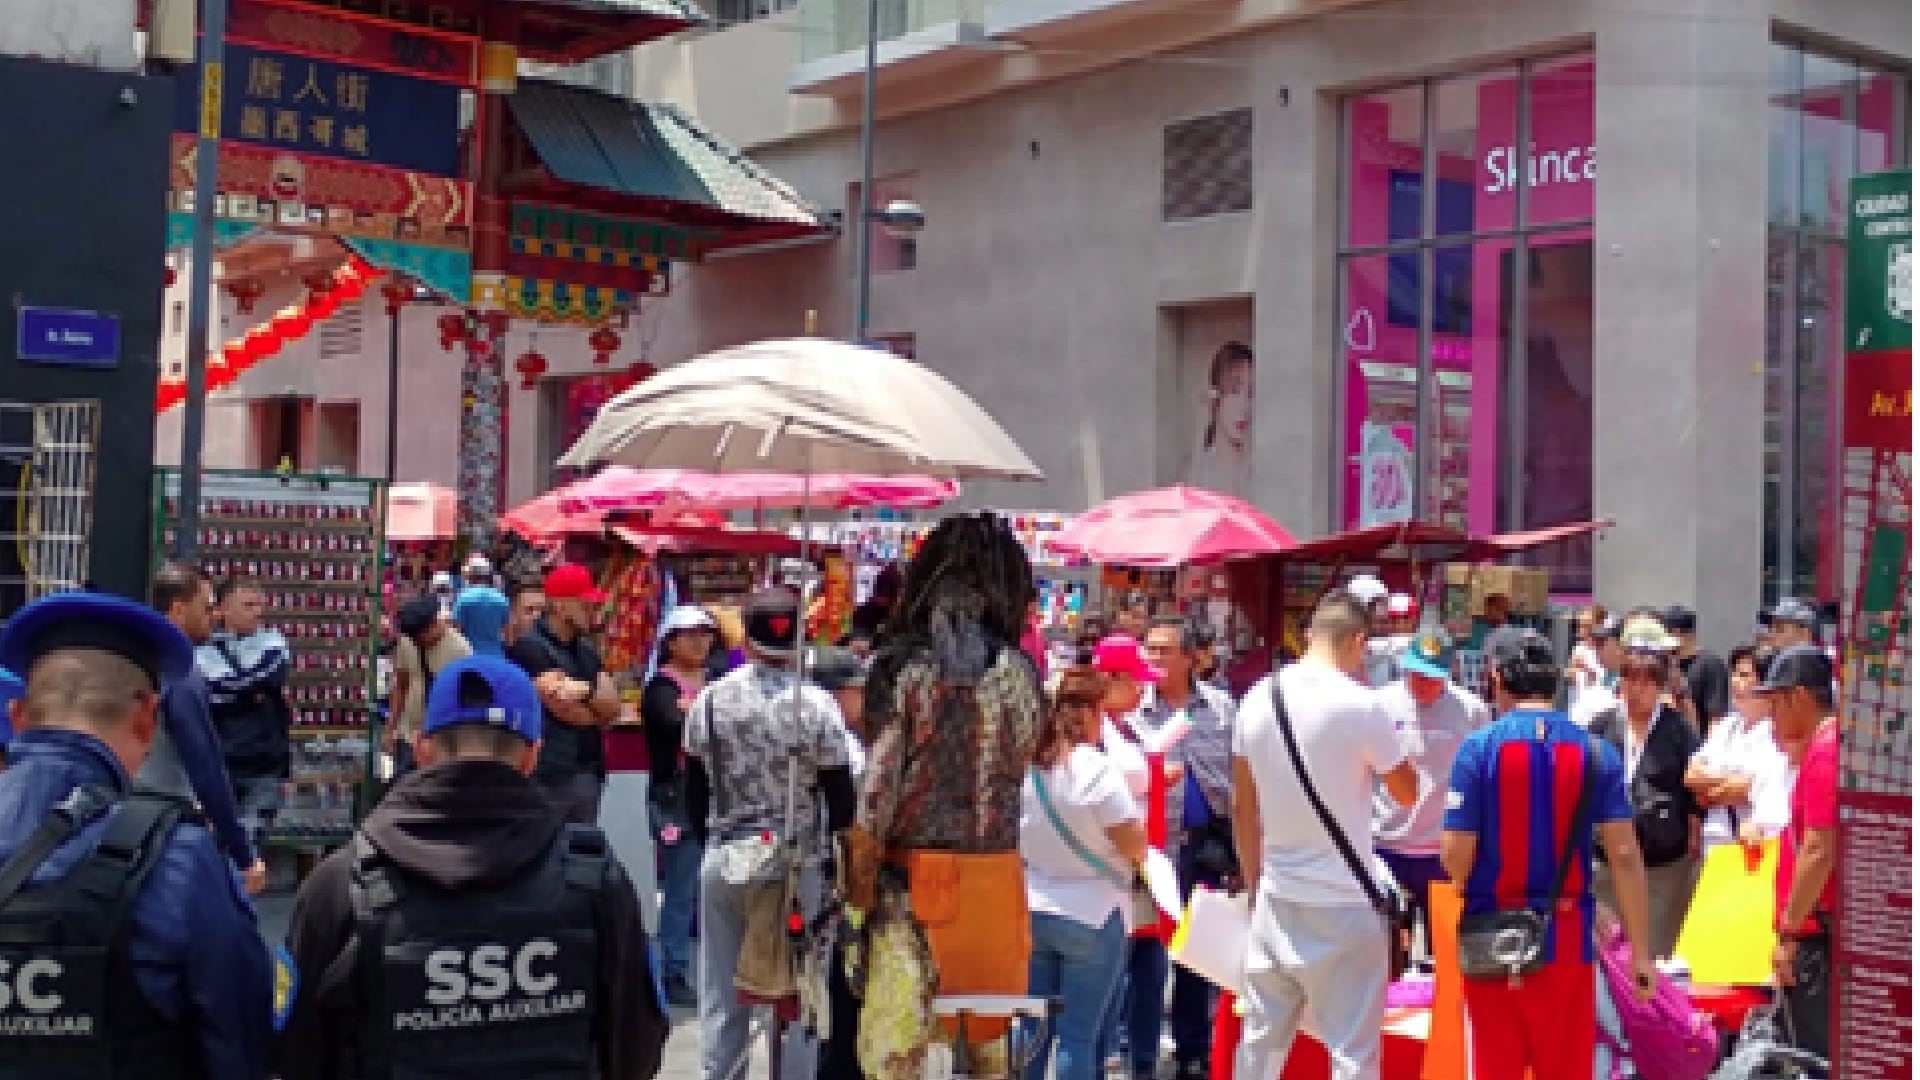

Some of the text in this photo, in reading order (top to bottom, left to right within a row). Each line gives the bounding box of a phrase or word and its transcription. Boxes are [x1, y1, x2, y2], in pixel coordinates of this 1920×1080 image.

[246, 57, 370, 112] 唐人街
[424, 938, 560, 1005] SSC
[489, 990, 585, 1020] AUXILIAR
